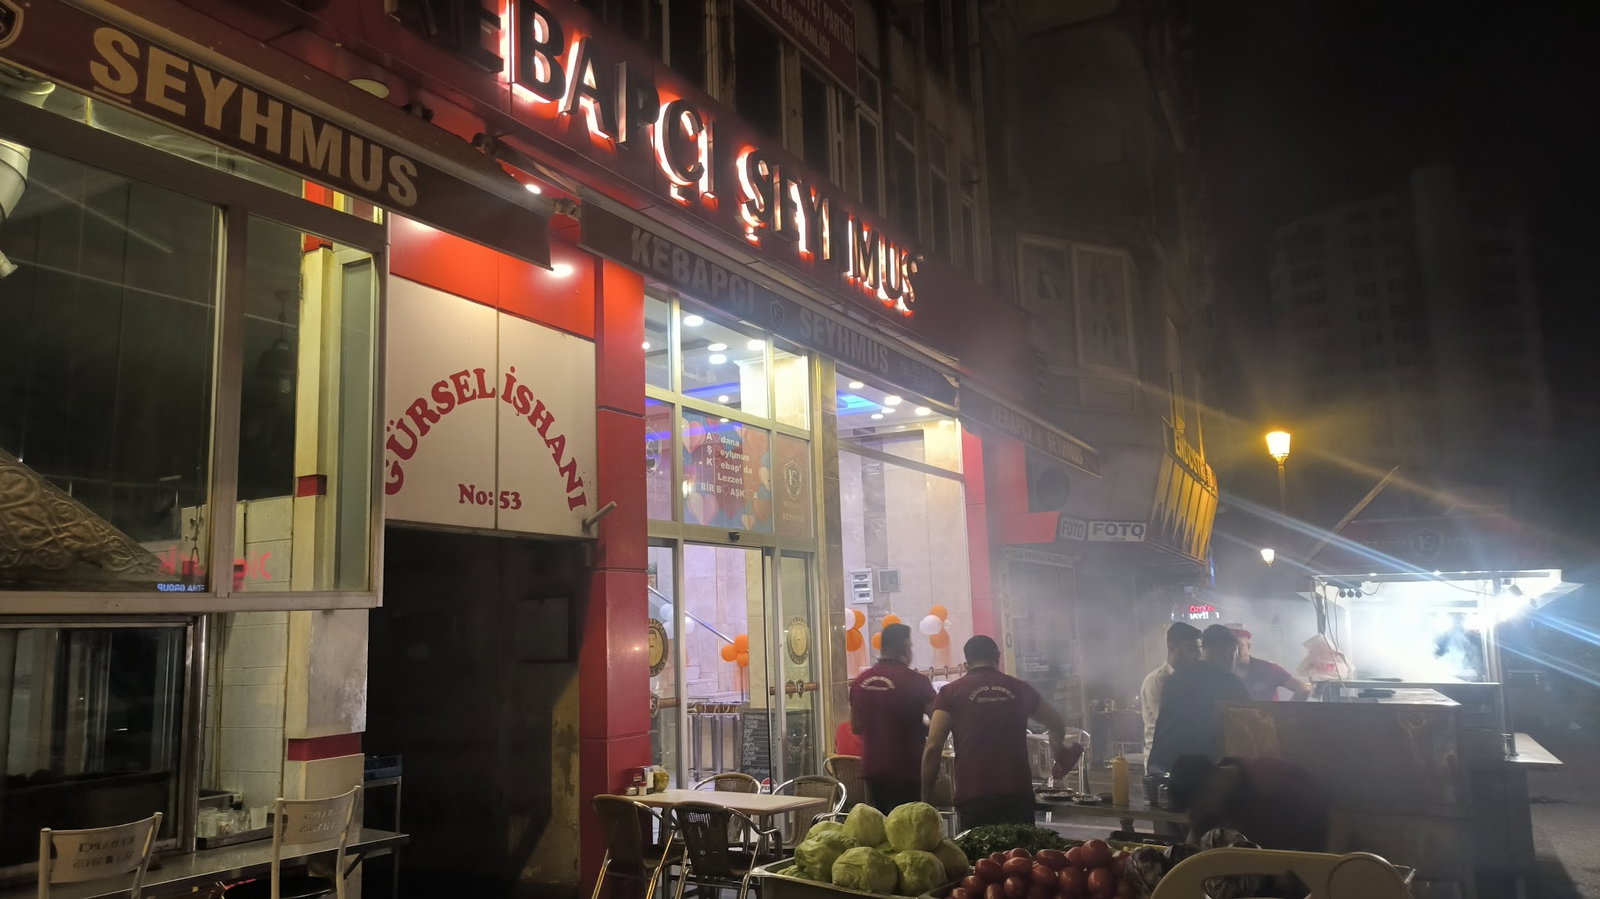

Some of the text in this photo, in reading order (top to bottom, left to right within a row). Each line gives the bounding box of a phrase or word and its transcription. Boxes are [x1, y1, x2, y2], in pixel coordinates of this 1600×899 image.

[384, 0, 718, 207] EBAPÇI
[385, 366, 588, 511] GÜRSEL İŞHANI
[720, 434, 740, 447] dana
[720, 448, 750, 462] eyhmus
[743, 465, 753, 475] da
[717, 472, 743, 485] Lezzet
[700, 482, 715, 493] BİR
[458, 483, 522, 510] No: 53
[1062, 519, 1084, 539] FOTO
